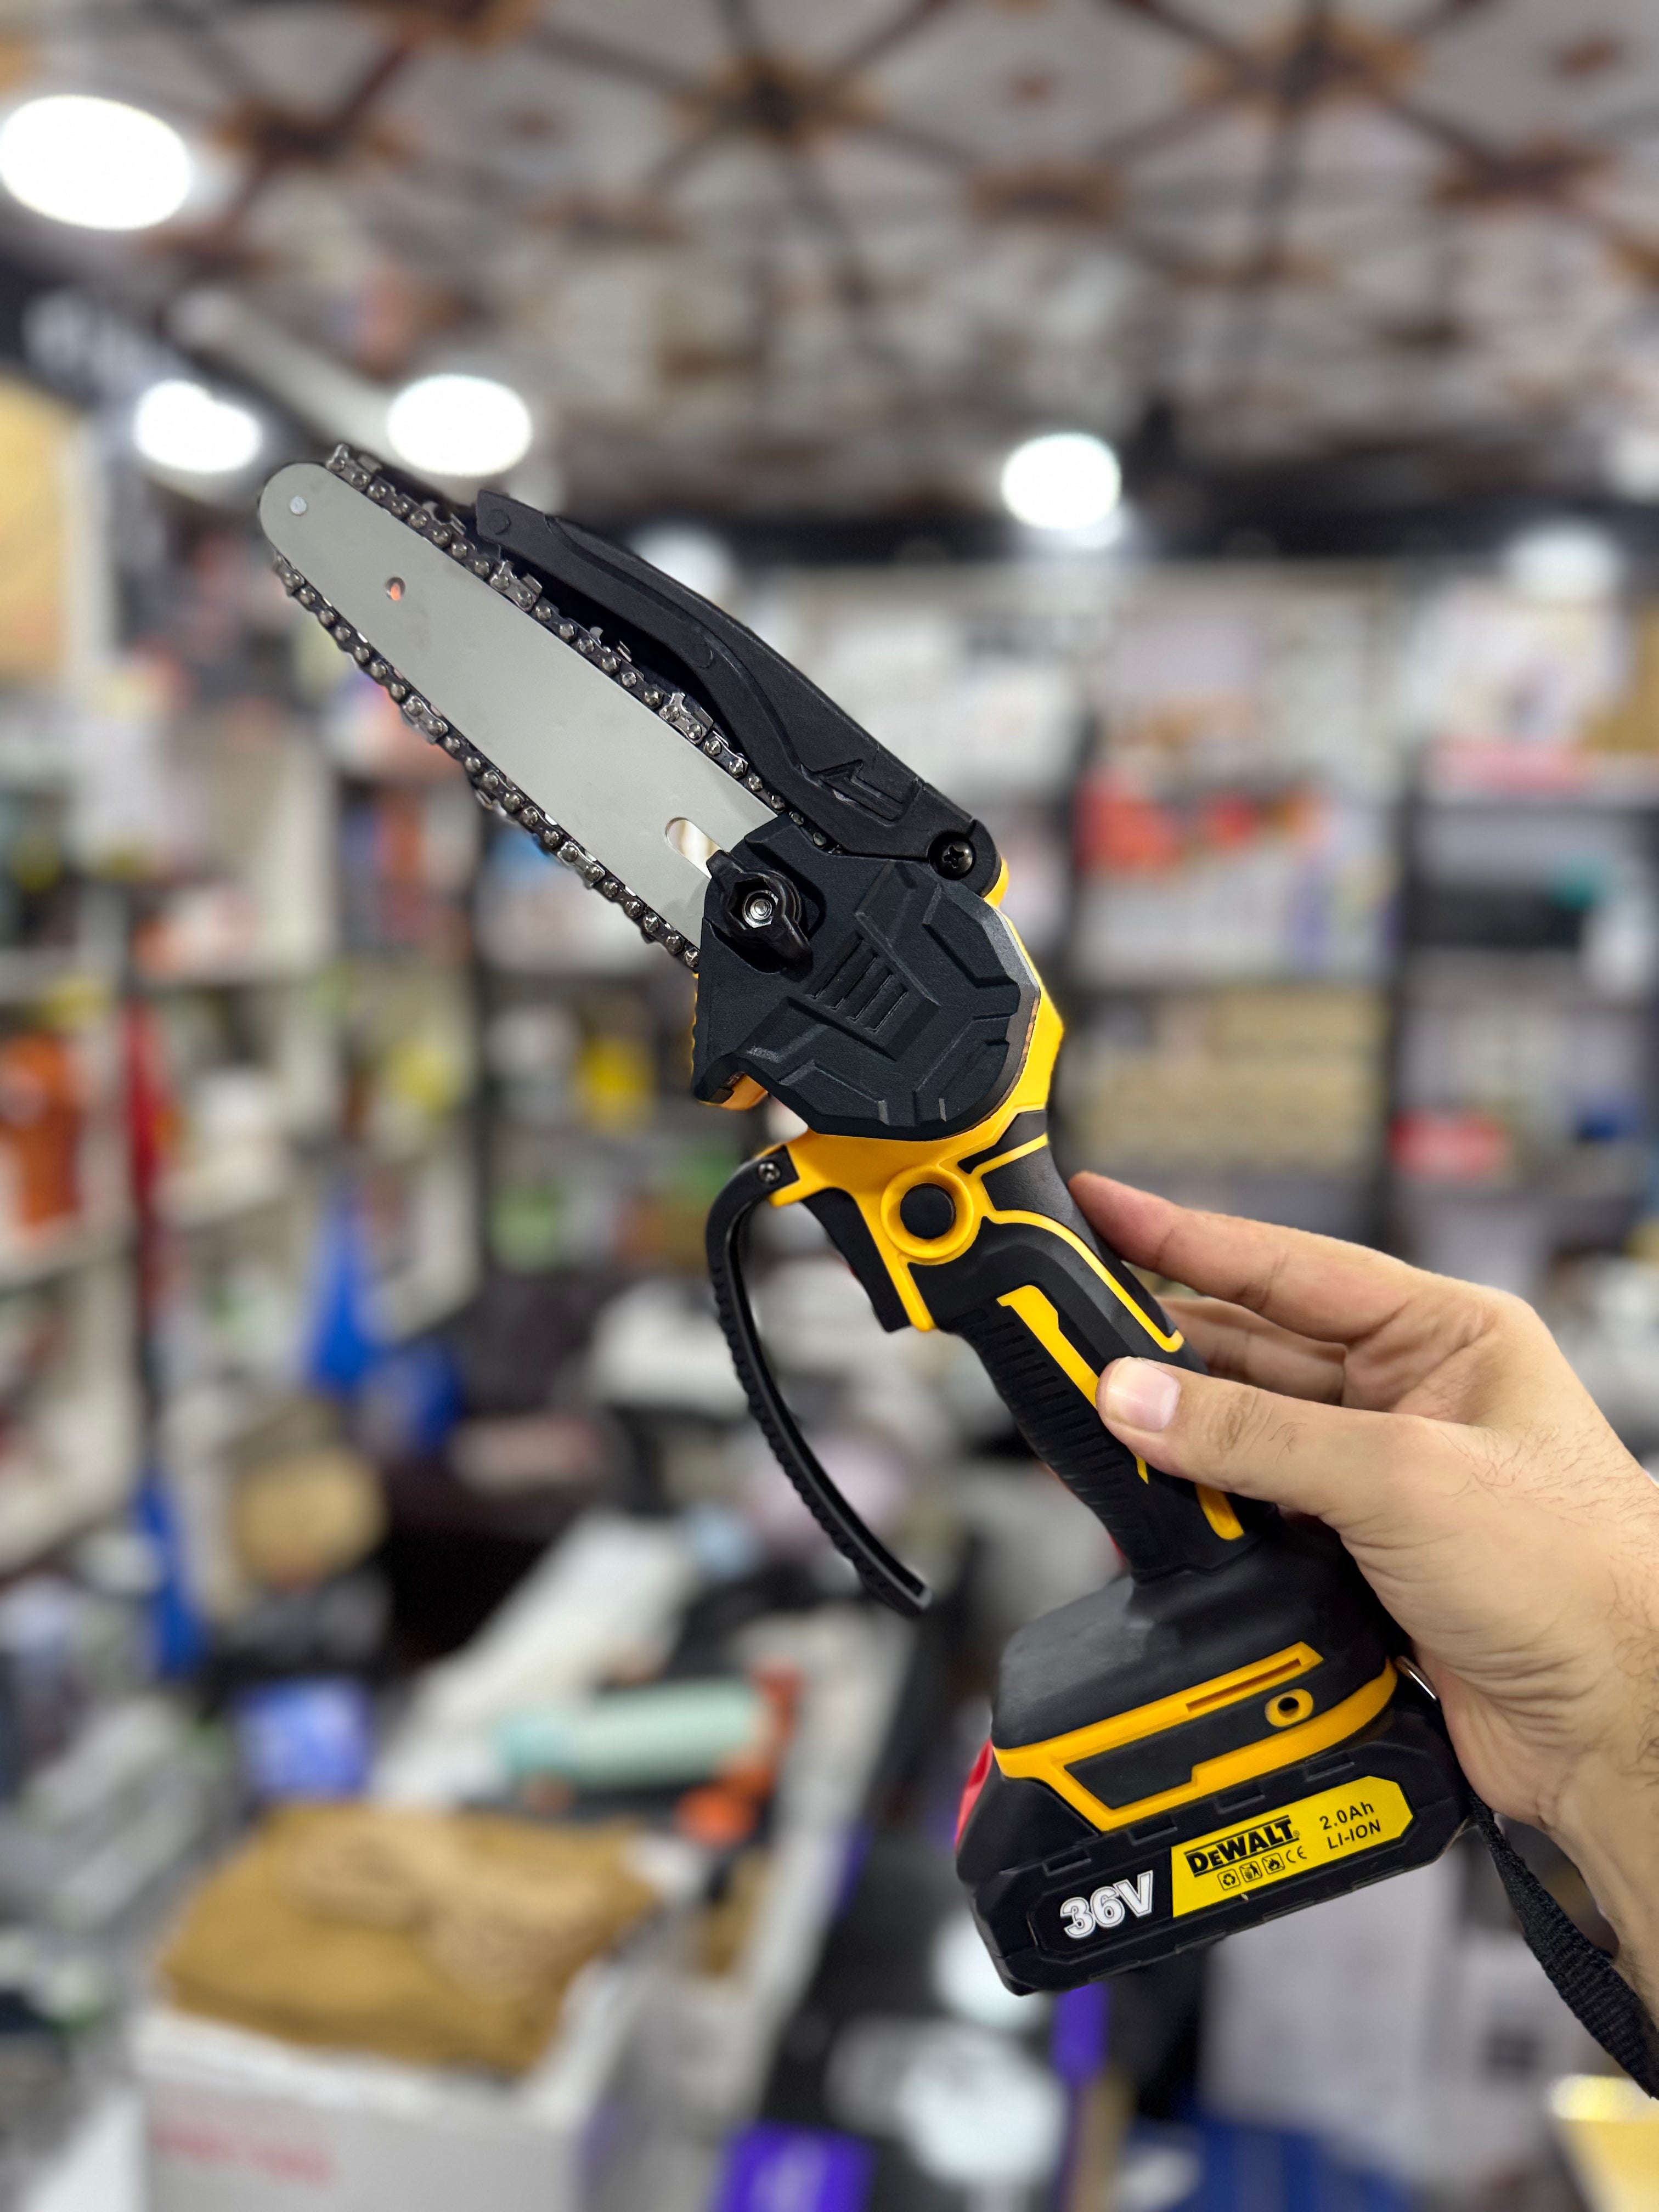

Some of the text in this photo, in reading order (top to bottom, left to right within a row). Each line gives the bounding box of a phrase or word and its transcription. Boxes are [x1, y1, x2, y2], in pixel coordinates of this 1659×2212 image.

[1319, 1802, 1374, 1831] 2.0Ah
[1327, 1819, 1381, 1849] LI-ION
[1059, 1870, 1153, 1940] 36V
